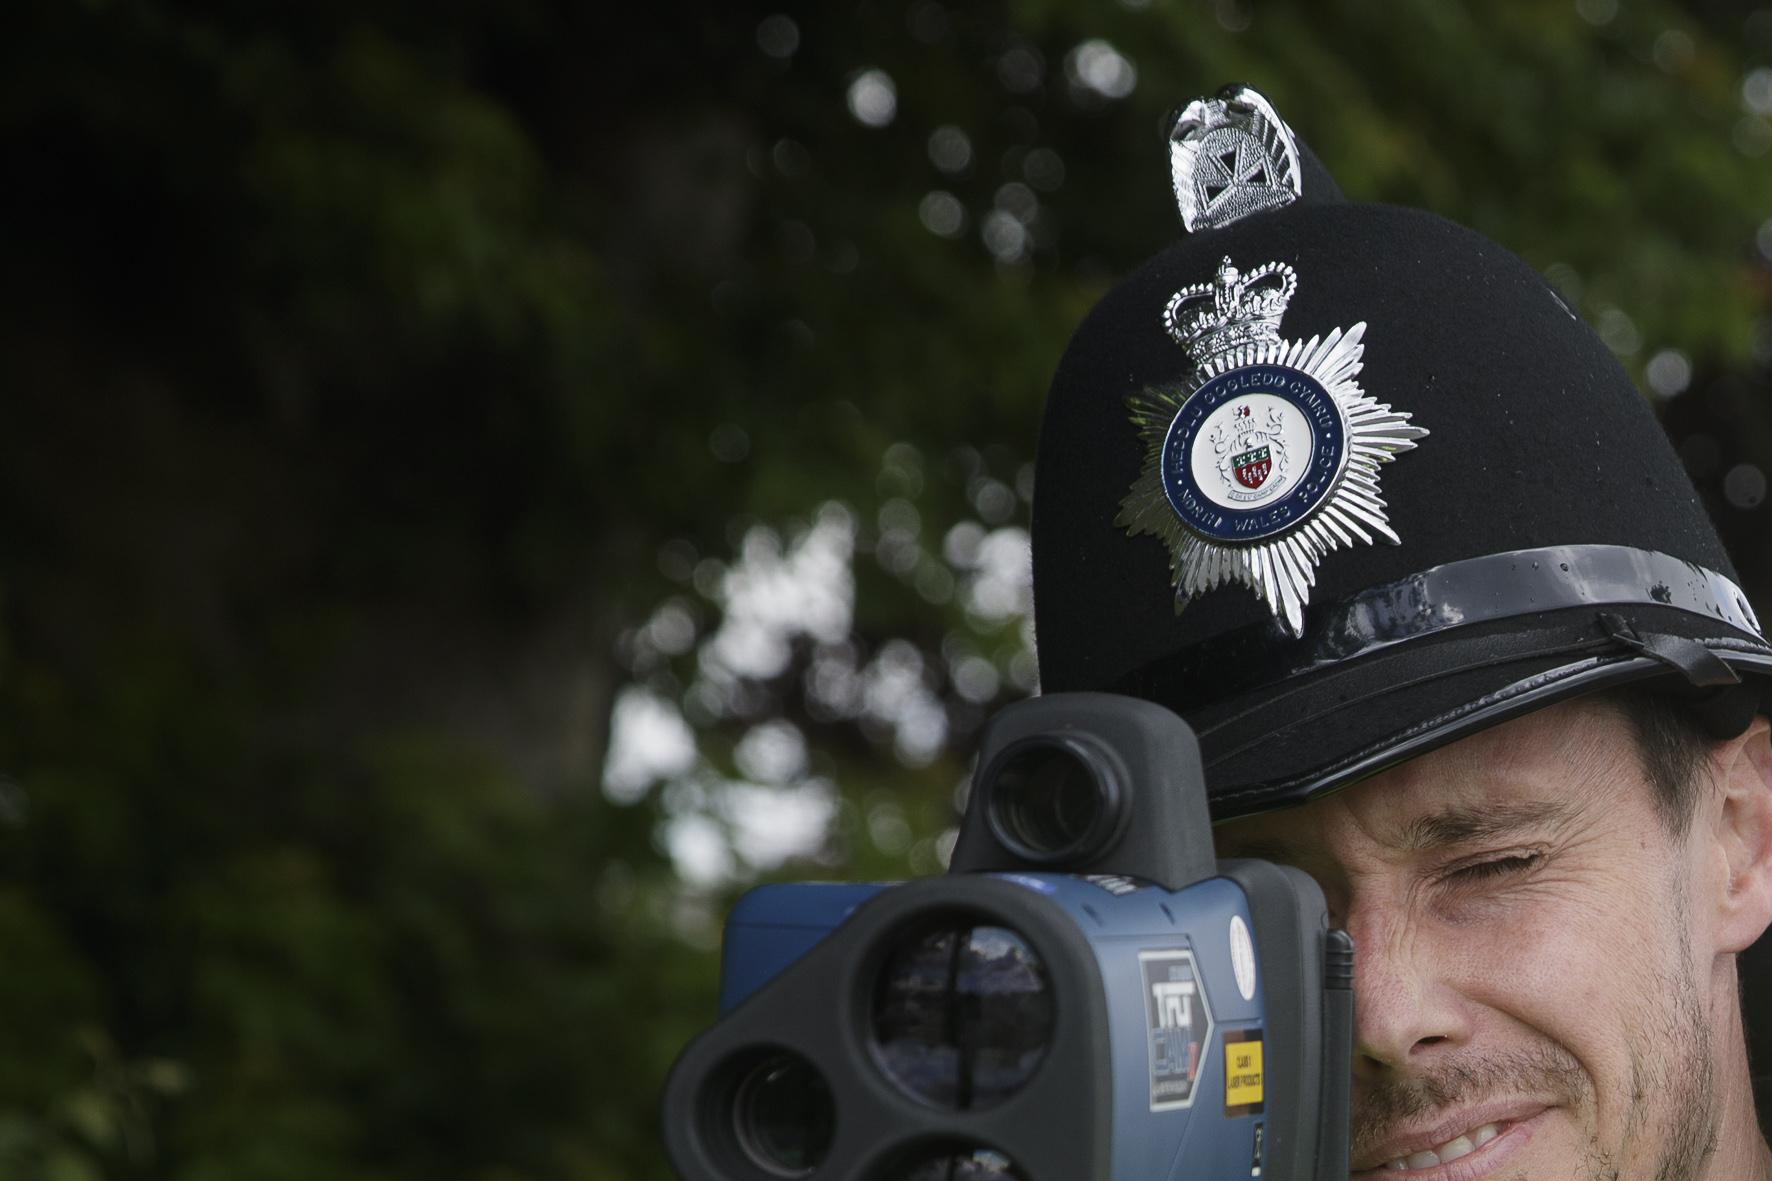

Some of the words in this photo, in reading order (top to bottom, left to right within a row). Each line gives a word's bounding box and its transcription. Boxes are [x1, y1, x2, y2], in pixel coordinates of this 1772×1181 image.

[1171, 408, 1202, 474] HEDDLU
[1204, 373, 1286, 404] GOGLEDD
[1289, 381, 1333, 429] CYMRU
[1179, 488, 1223, 528] NORTH
[1234, 505, 1291, 531] WALES
[1299, 445, 1335, 503] POLICE
[1228, 1075, 1240, 1089] LASER
[1236, 1056, 1248, 1068] CLASS
